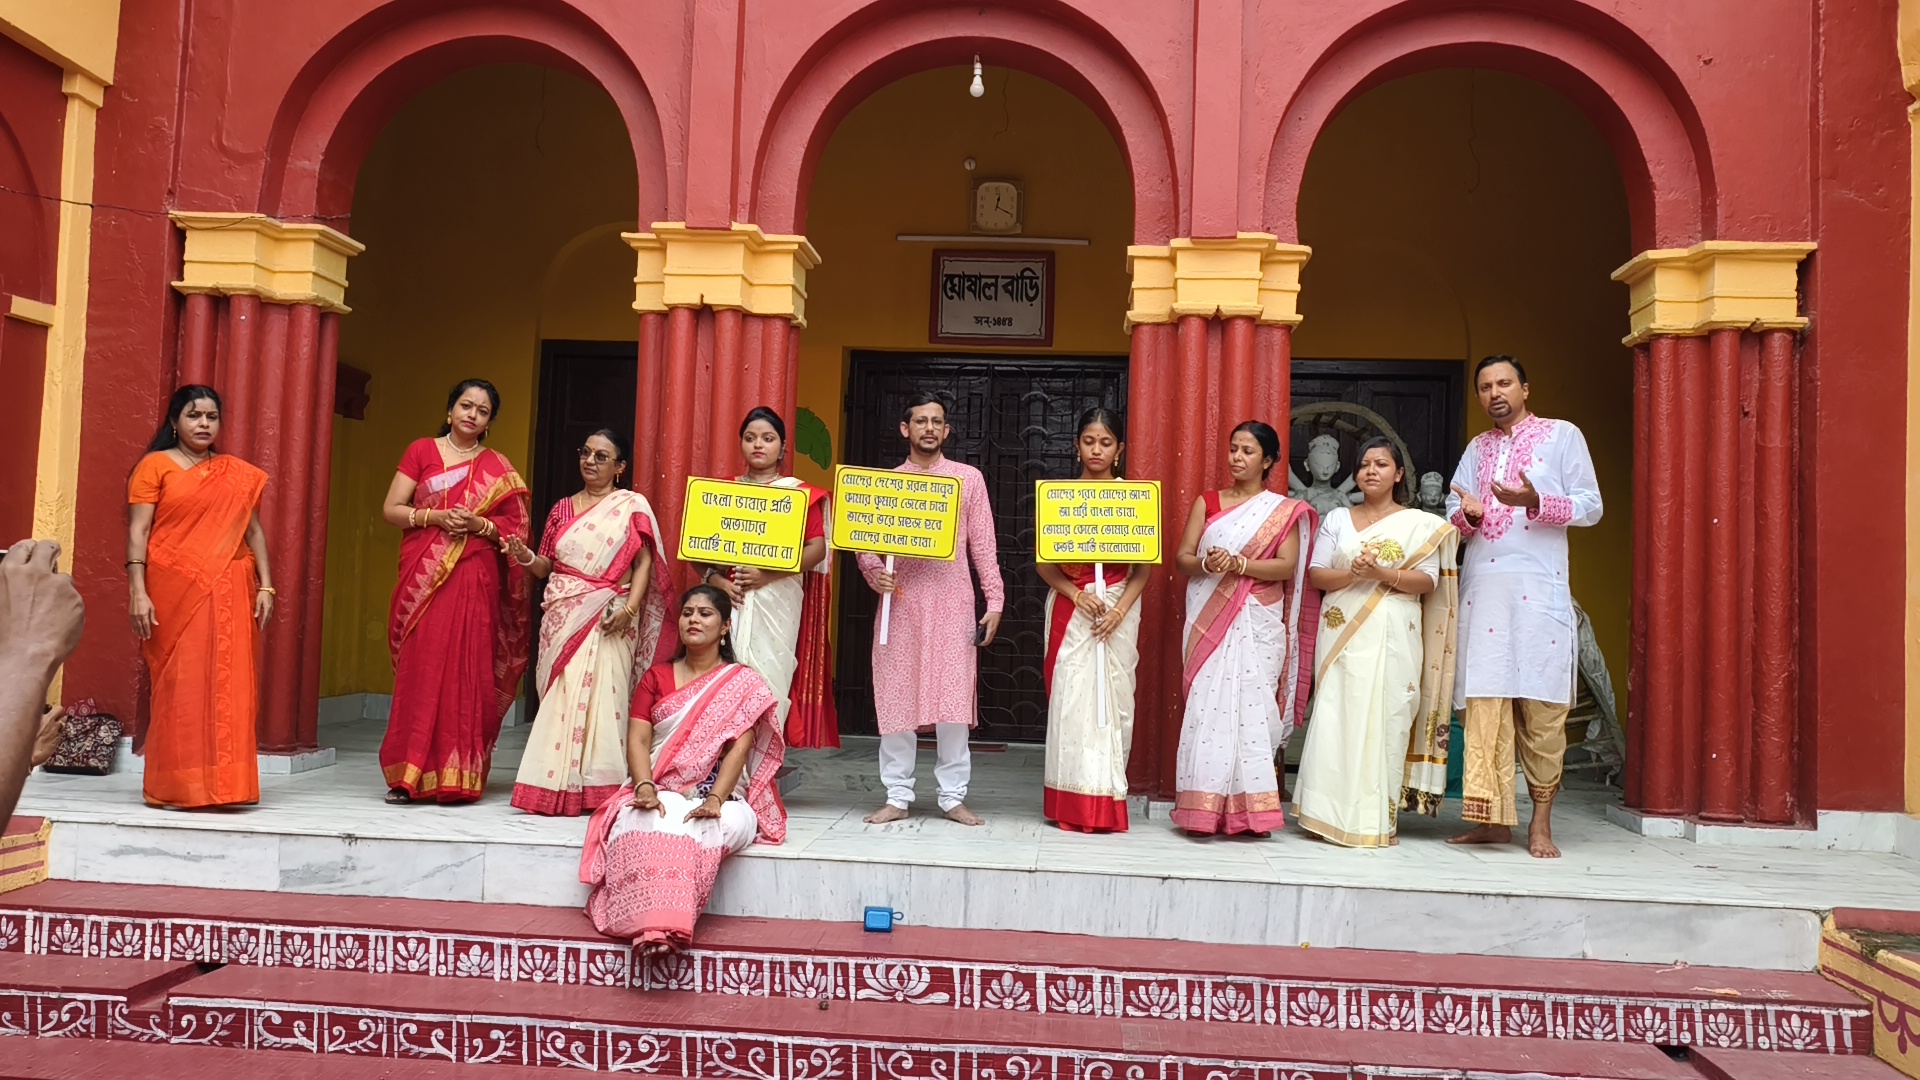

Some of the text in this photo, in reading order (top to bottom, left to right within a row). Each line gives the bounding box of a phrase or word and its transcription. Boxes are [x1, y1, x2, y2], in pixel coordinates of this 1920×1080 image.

[944, 267, 1039, 306] ঘোষাল বাড়ি
[842, 474, 954, 499] মোদের দেশের সরল মানুষ
[1047, 489, 1150, 500] মোদের গরব মোদের আশা
[702, 492, 792, 513] বাংলা ভাষার প্রতি
[845, 492, 948, 512] কামার কুমার জেলে চাষা
[1059, 502, 1138, 519] আ মরি বাংলা ভাষা,
[721, 517, 767, 535] অত্যাচার
[847, 511, 942, 530] তাদের তরে সহজ হবে
[850, 530, 880, 544] মোদের
[883, 533, 908, 545] বাংলা
[1043, 525, 1155, 536] তোমার কোলে তোমার বোলে
[689, 533, 794, 559] মানছি না, মানবো না
[1054, 540, 1075, 552] কতই
[1078, 538, 1097, 552] শান্তি
